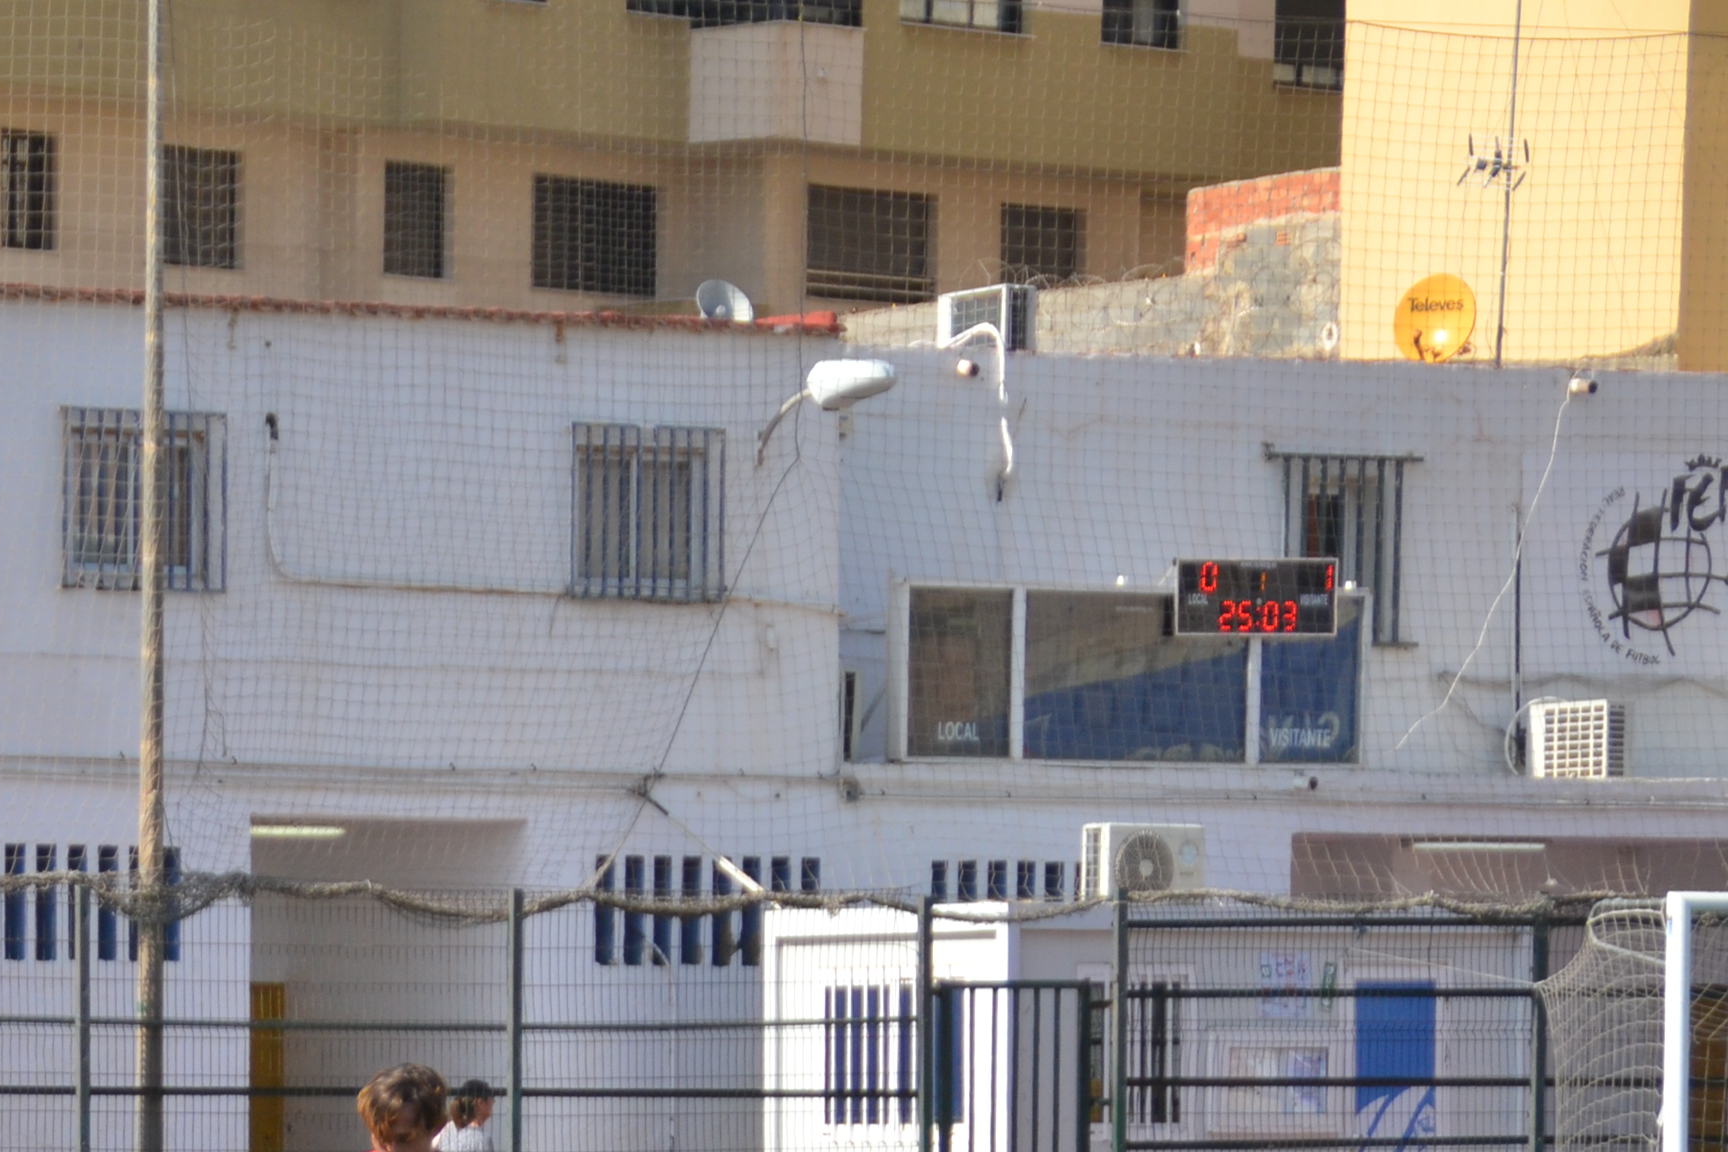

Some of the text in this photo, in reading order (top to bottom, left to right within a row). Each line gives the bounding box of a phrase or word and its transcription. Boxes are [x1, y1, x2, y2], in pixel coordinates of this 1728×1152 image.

[1200, 561, 1219, 593] 0
[1325, 564, 1334, 591] 1
[1188, 593, 1208, 605] LOCAL
[1219, 600, 1298, 633] 25:03
[1610, 640, 1624, 654] DE
[938, 721, 979, 740] LOCAL
[1270, 728, 1331, 748] VISITANTE
